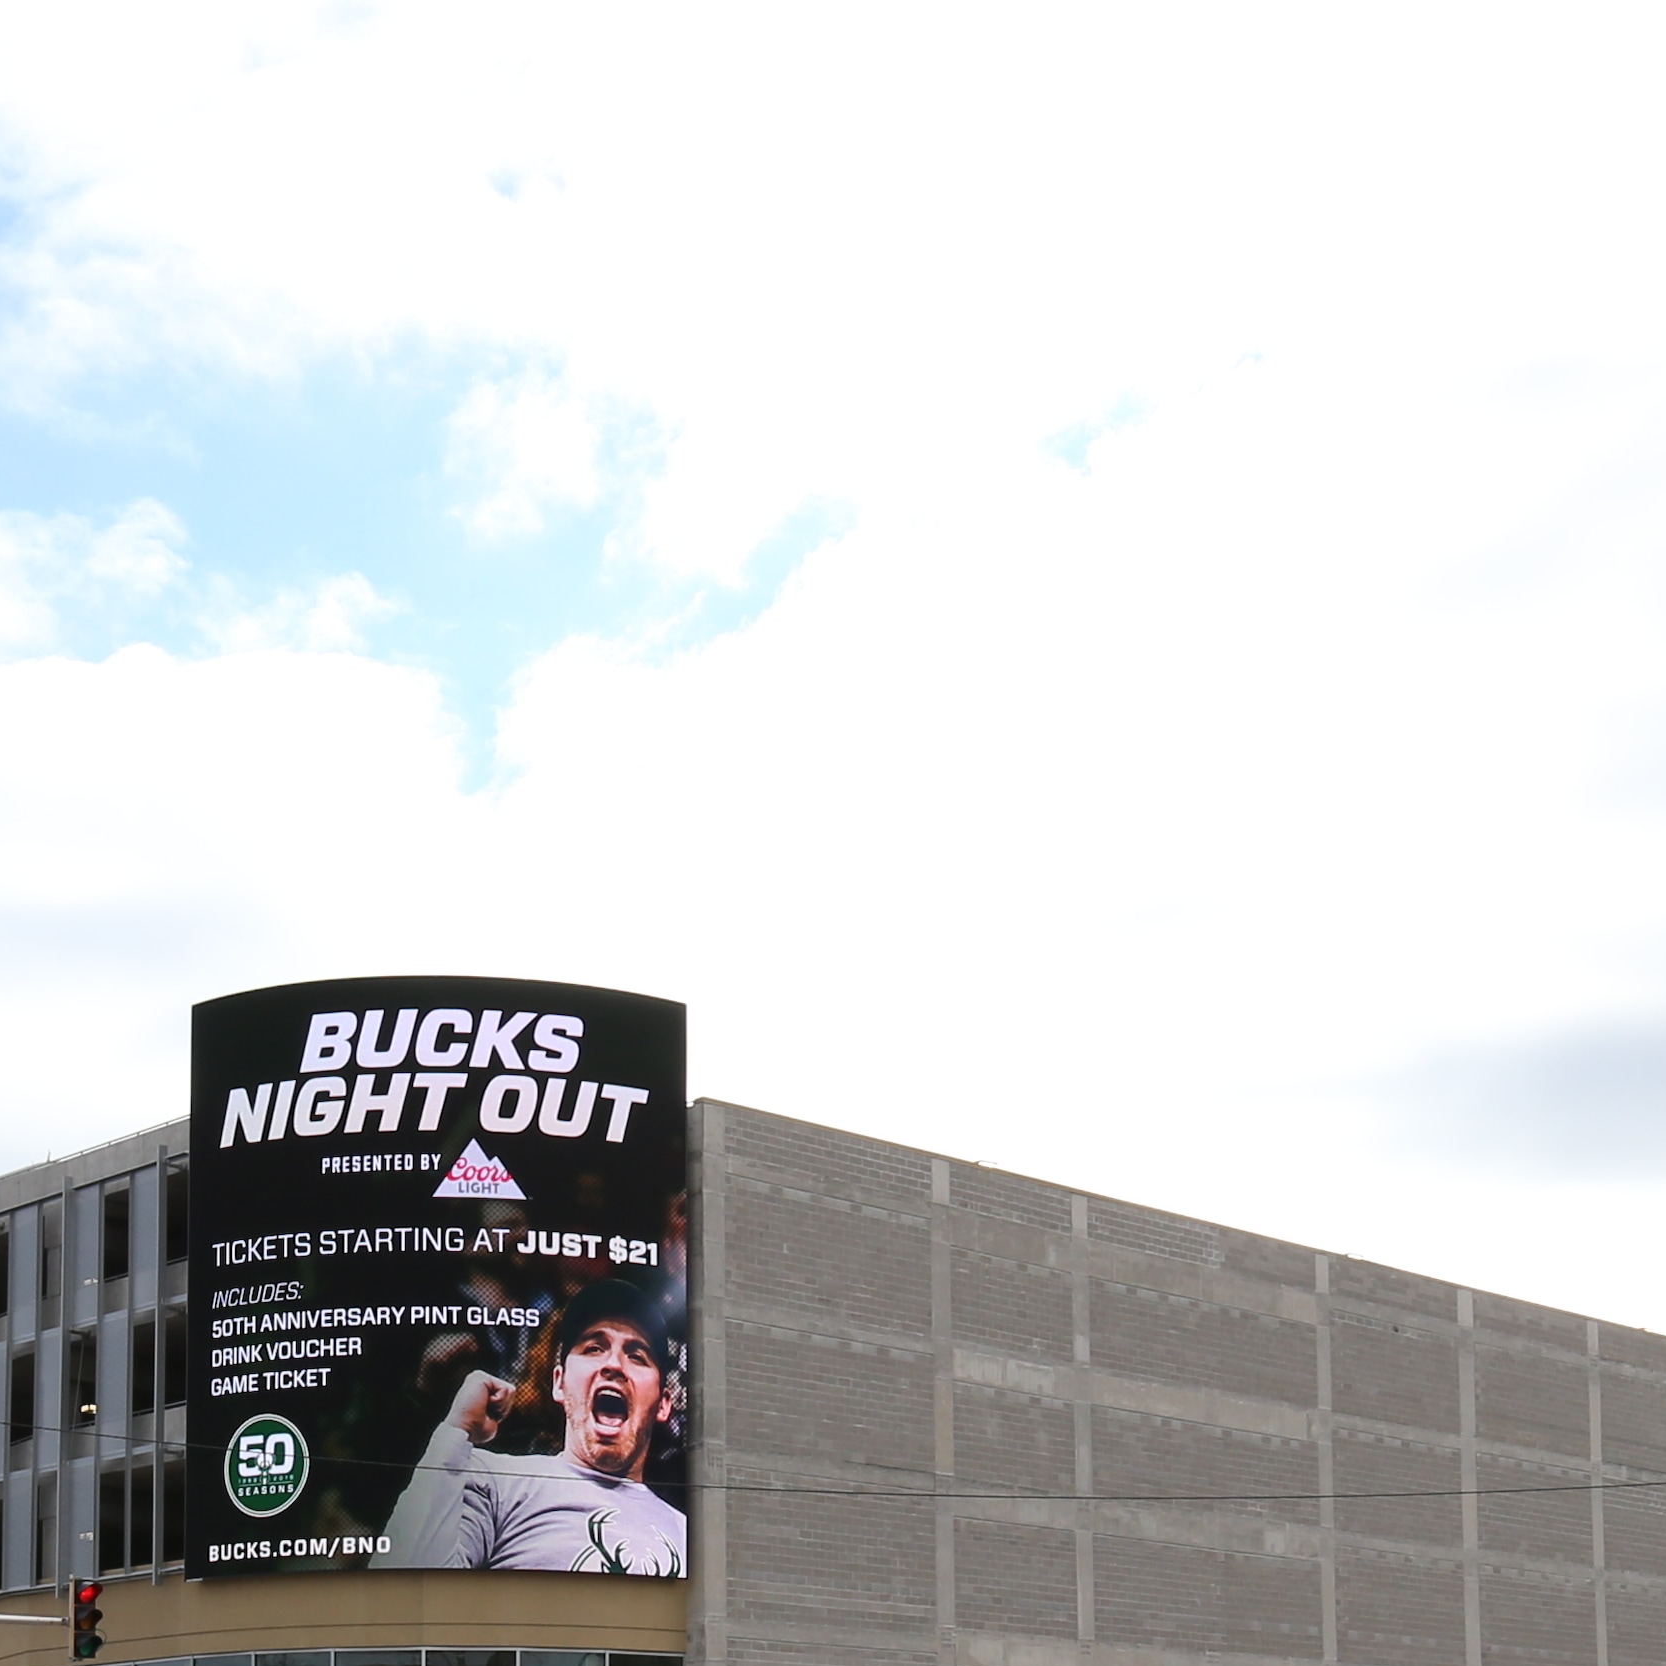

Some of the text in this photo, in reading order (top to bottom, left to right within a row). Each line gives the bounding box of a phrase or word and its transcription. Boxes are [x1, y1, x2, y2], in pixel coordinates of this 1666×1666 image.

[299, 1008, 584, 1073] BUCKS
[219, 1073, 649, 1149] NIGHT OUT
[321, 1154, 441, 1174] PRESENTED BY
[446, 1157, 513, 1182] Coors
[458, 1182, 499, 1193] LIGHT
[212, 1227, 659, 1266] TICKETS STARTING AT JUST $21
[212, 1282, 304, 1309] INCLUDES:
[212, 1306, 540, 1338] 50TH ANNIVERSARY PINT GLASS
[212, 1337, 362, 1368] DRINK VOUCHER
[211, 1368, 331, 1397] GAME TICKET
[238, 1433, 294, 1477] 50
[238, 1484, 294, 1496] SEASONS
[209, 1536, 391, 1562] BUCKS.COM/BNO
